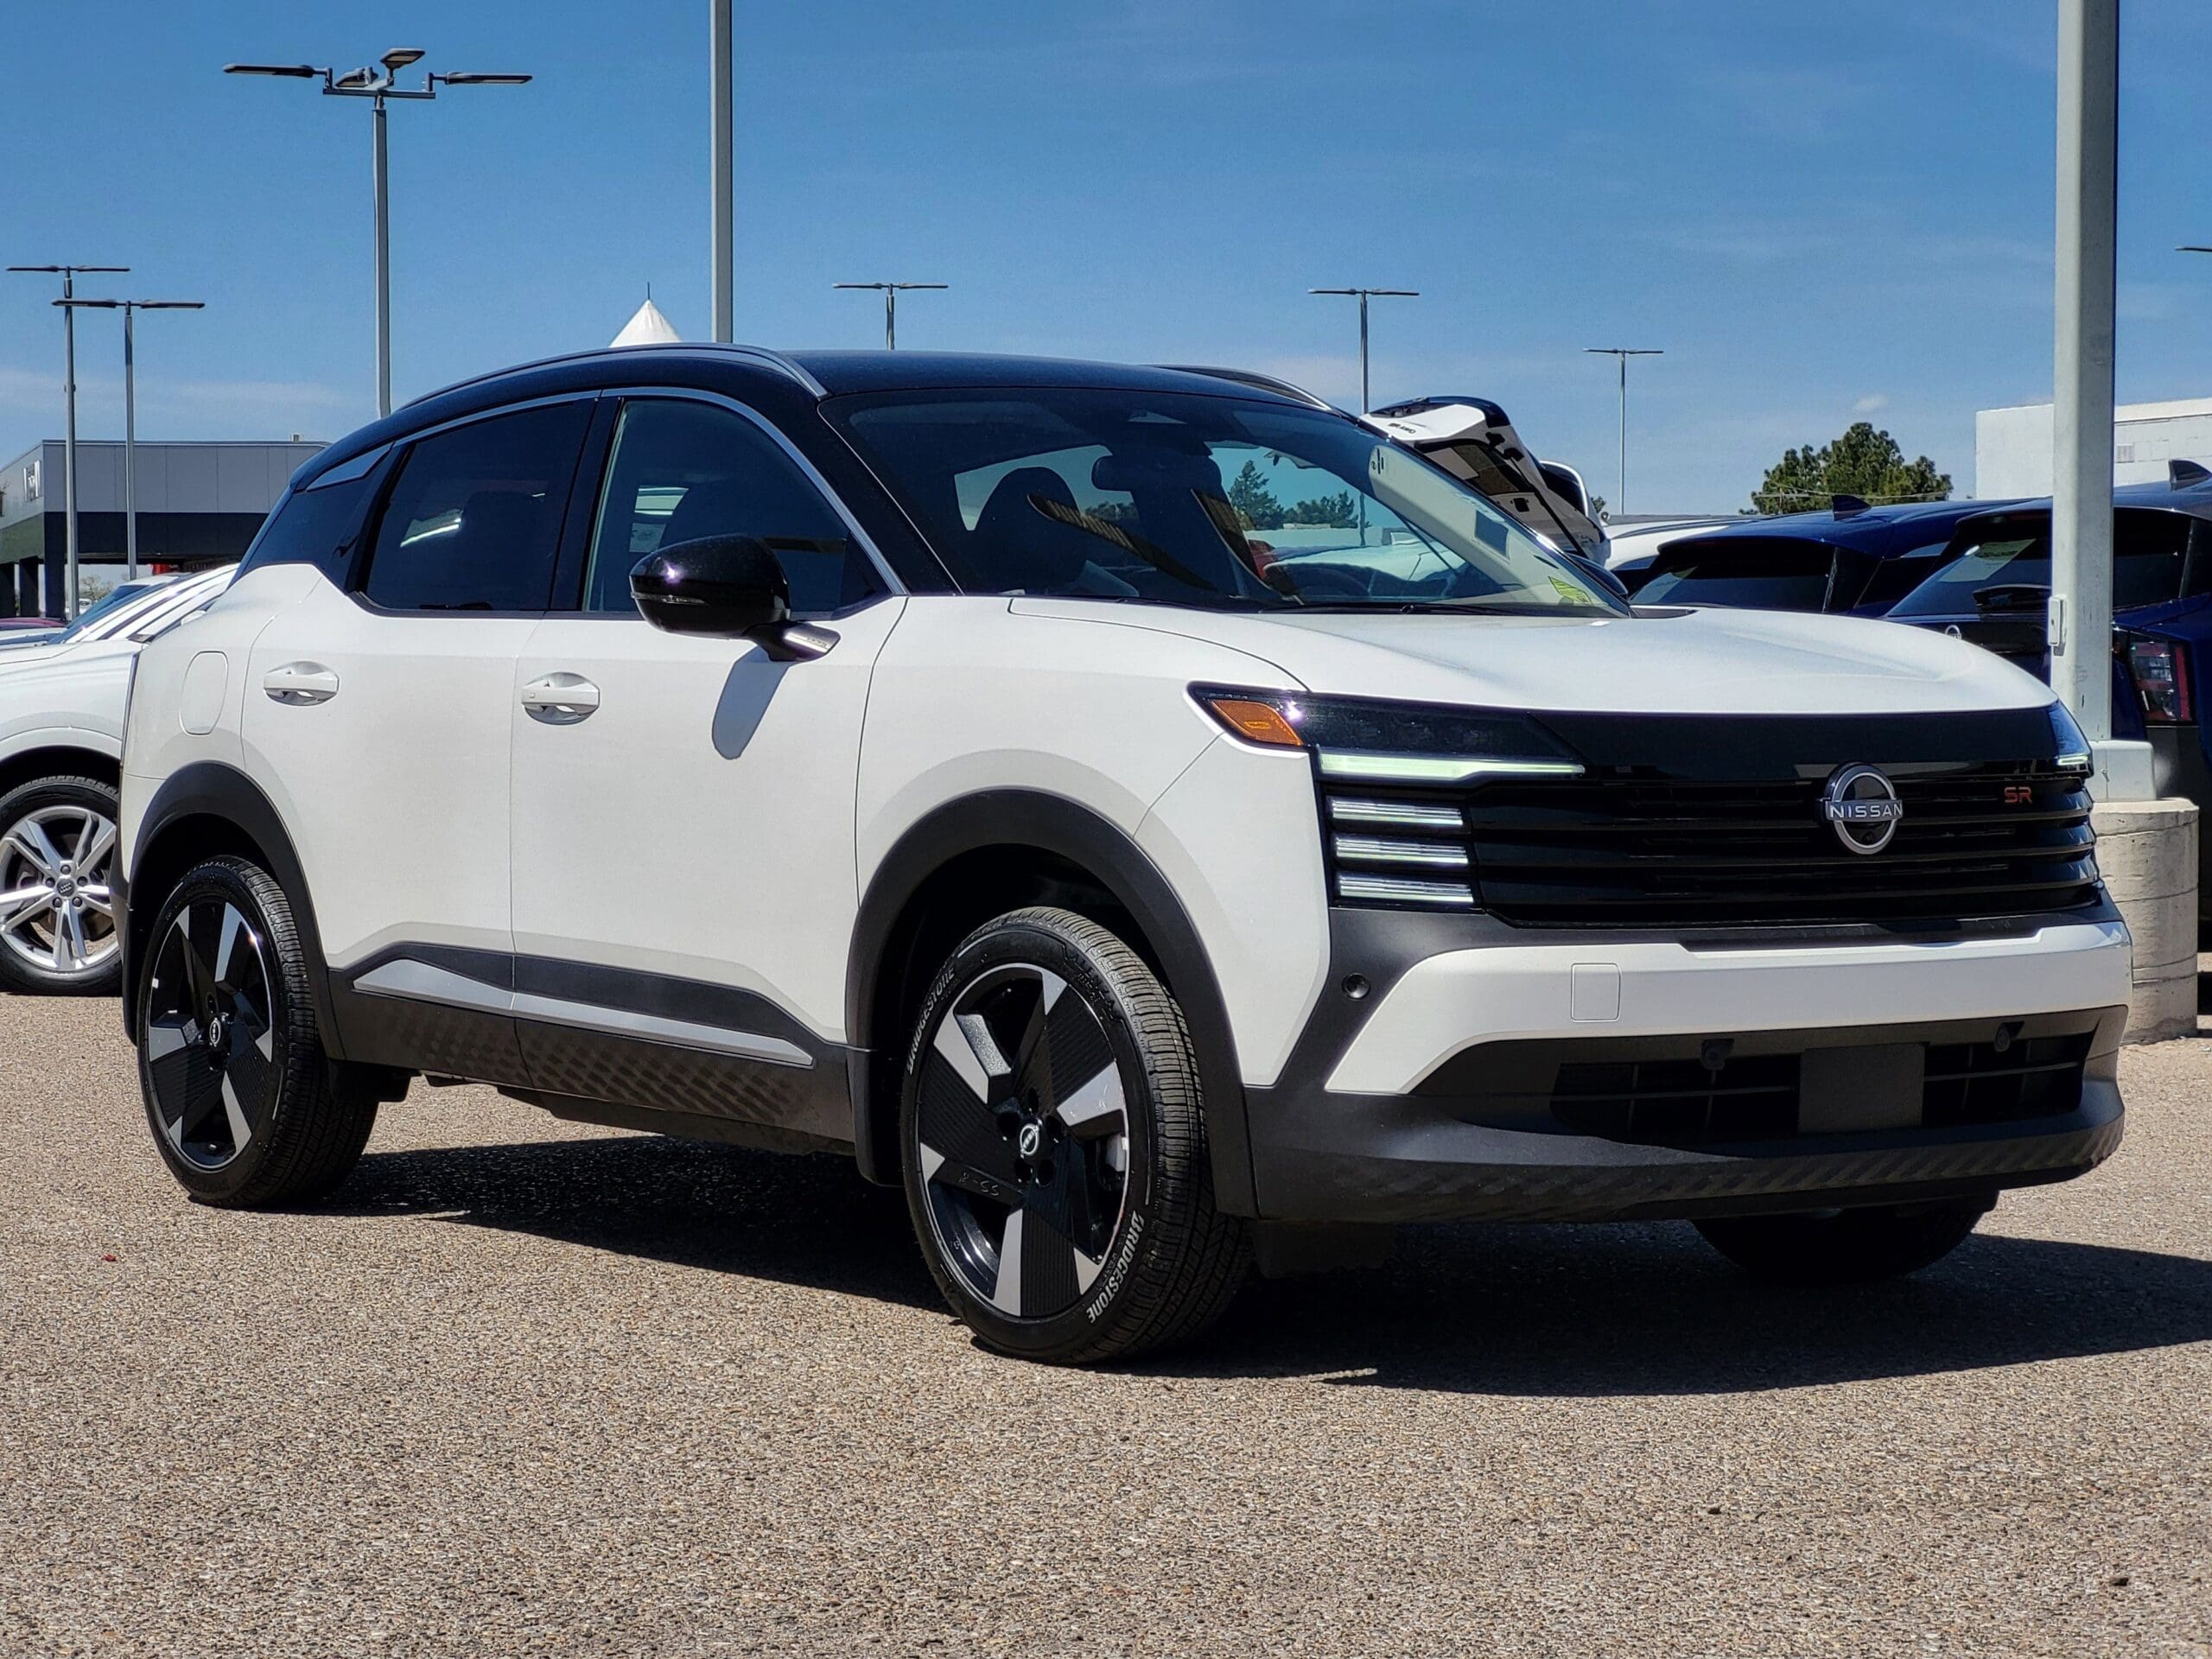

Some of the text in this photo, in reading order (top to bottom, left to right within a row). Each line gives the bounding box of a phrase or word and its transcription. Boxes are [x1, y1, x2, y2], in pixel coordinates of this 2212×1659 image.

[2004, 787, 2031, 803] SR
[1829, 804, 1902, 818] NISSAN
[1086, 1210, 1145, 1324] BRIDGESTONE
